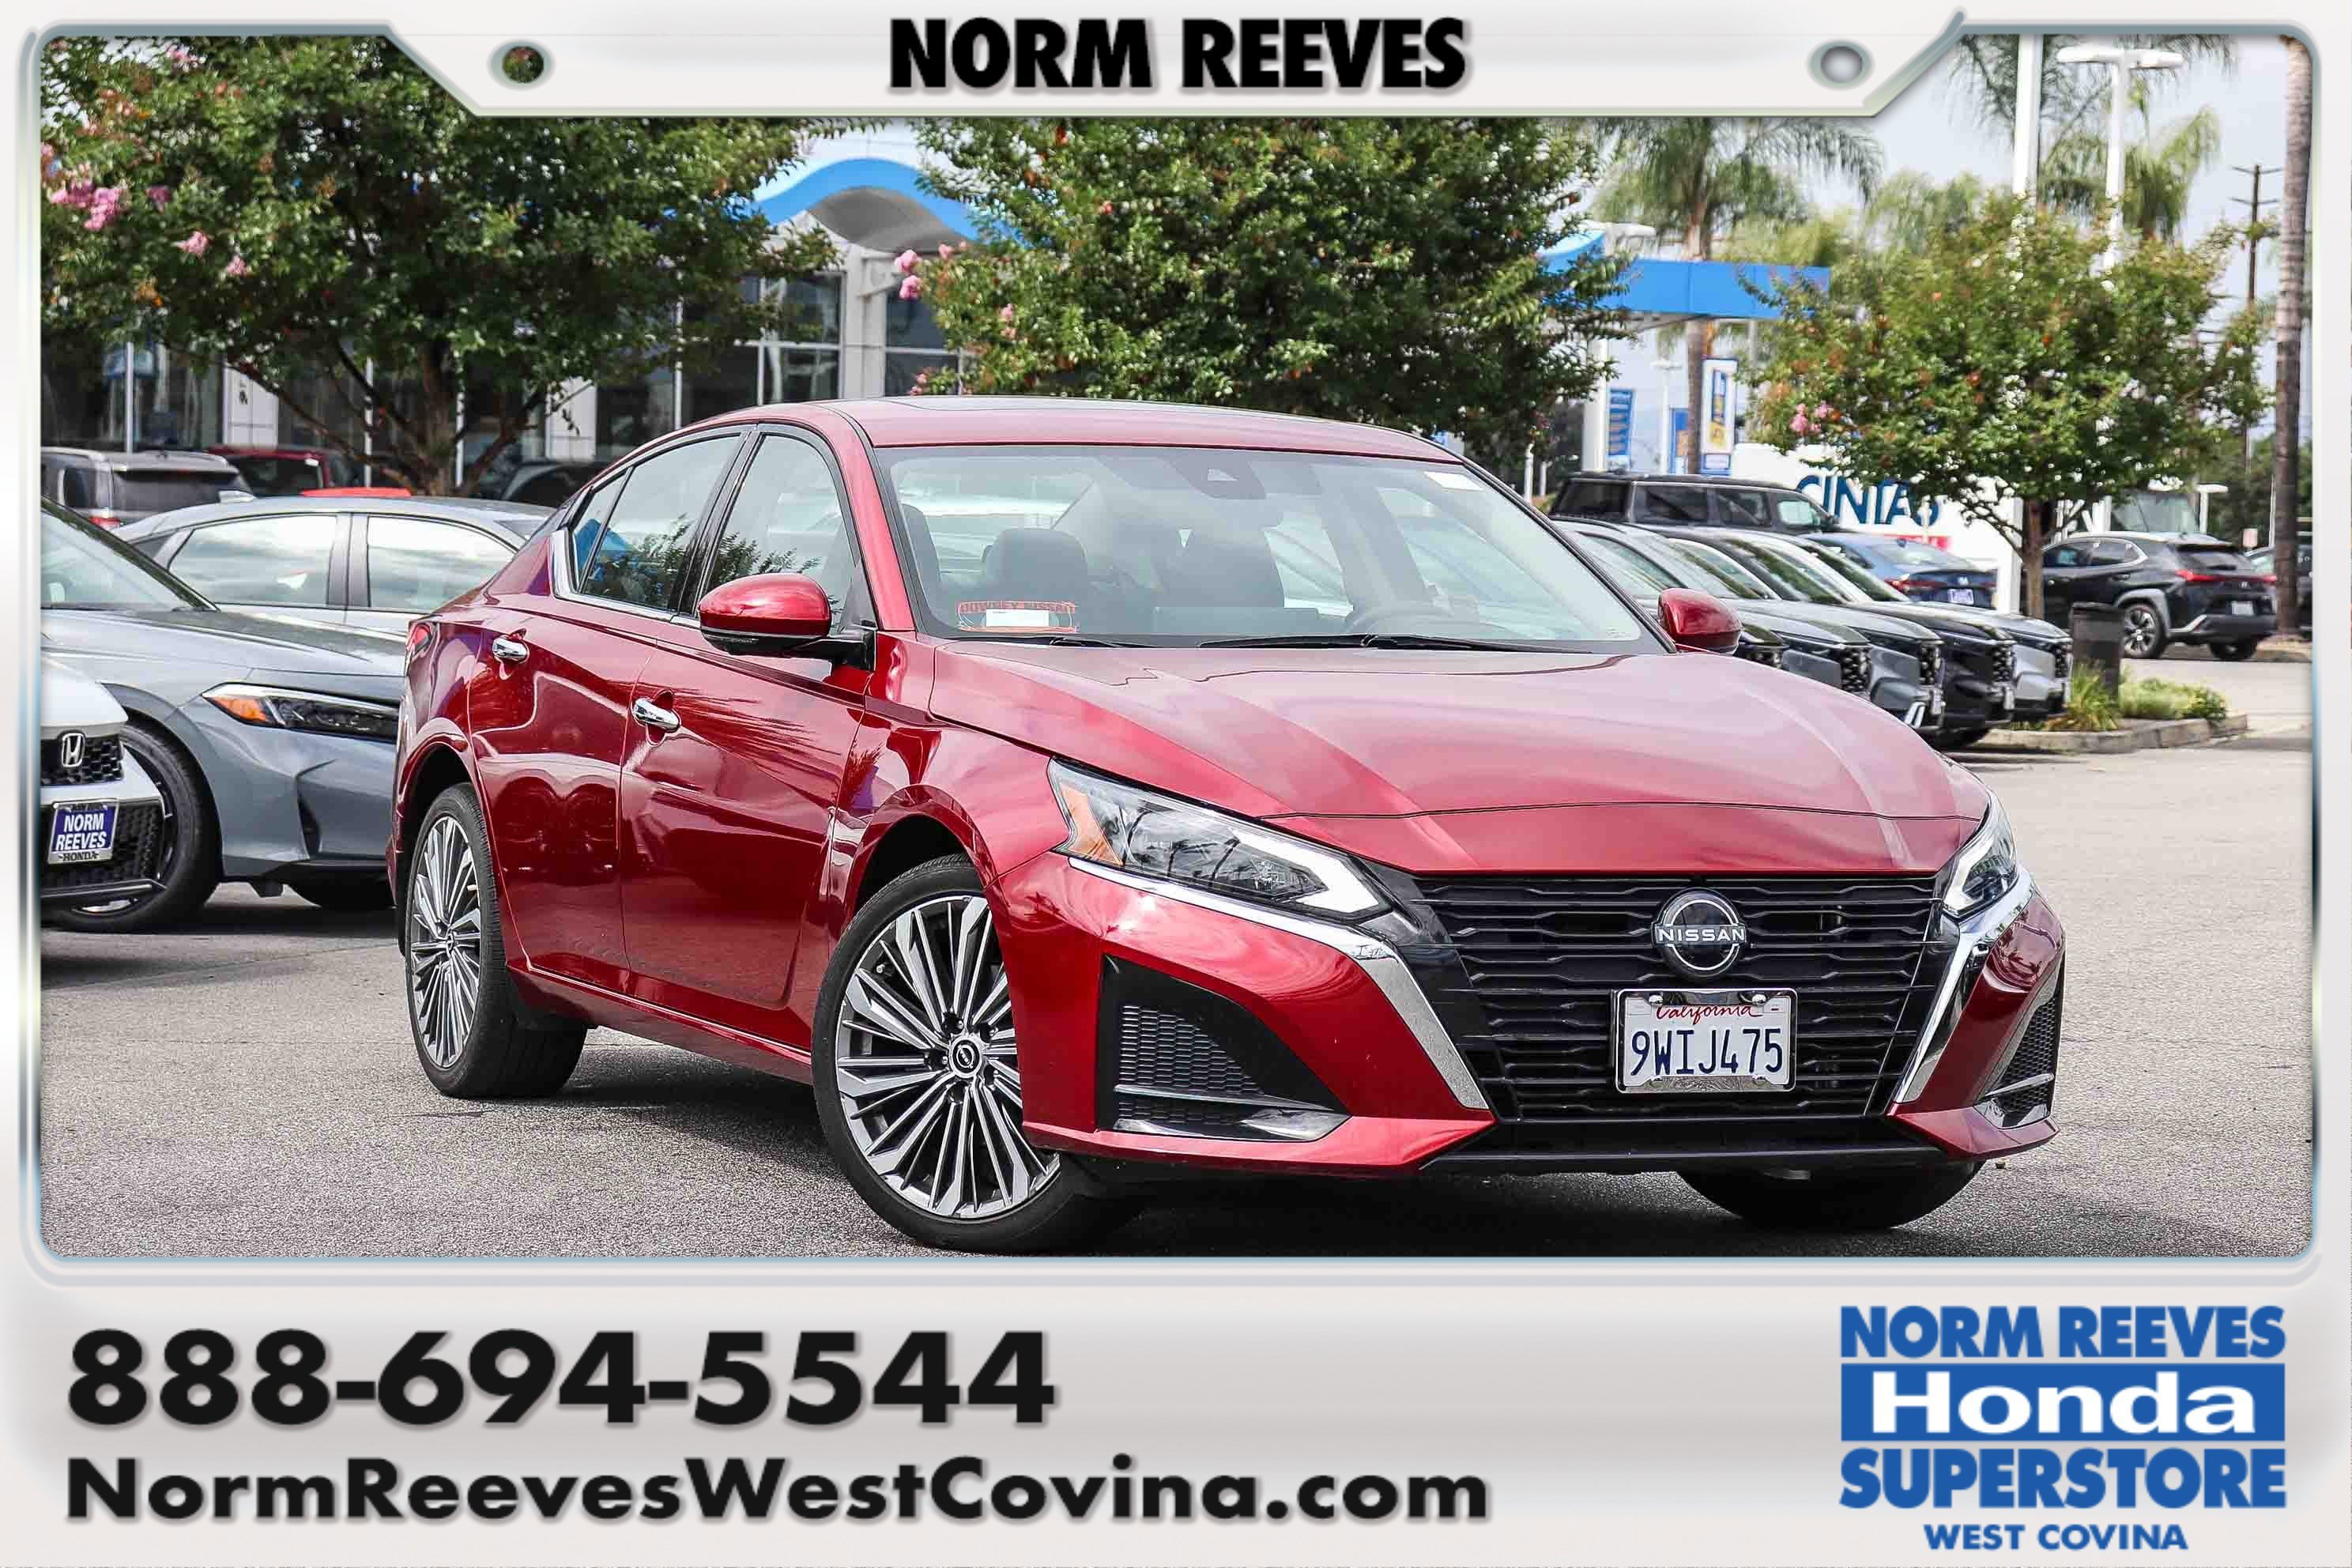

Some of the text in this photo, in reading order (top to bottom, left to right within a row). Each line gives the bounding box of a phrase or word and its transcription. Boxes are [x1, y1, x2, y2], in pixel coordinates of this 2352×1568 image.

[63, 813, 104, 832] NORM
[55, 831, 107, 851] REEVES
[1659, 928, 1745, 942] NISSAN
[1657, 1004, 1763, 1026] California
[1630, 1028, 1783, 1076] 9WIJ475
